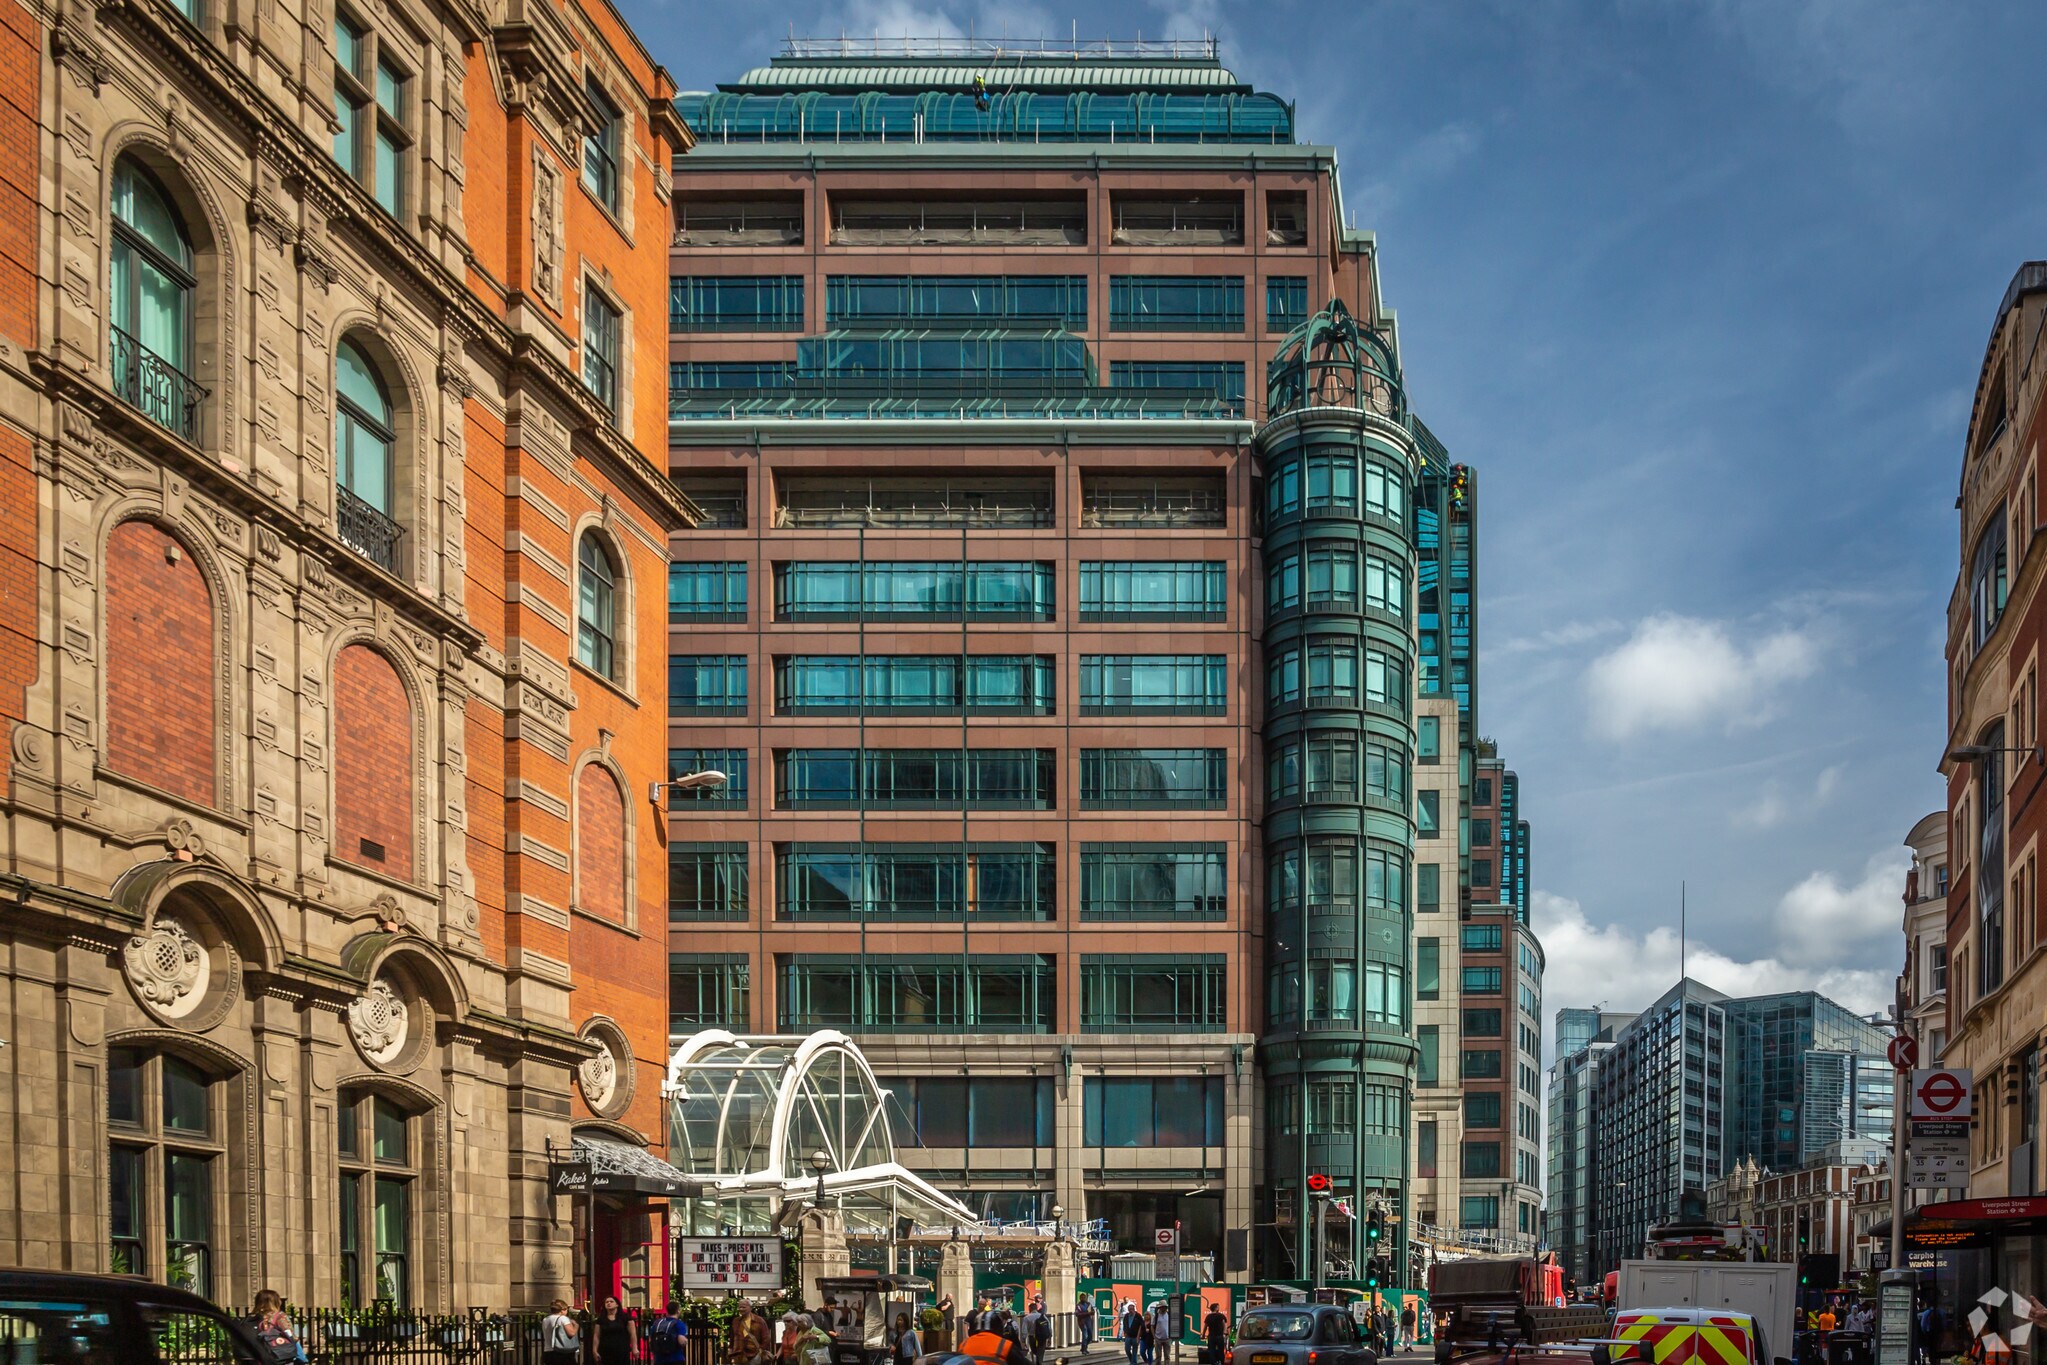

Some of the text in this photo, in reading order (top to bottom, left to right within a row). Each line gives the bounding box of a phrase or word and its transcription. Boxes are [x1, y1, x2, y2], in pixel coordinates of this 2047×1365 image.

[1895, 1041, 1911, 1064] K
[556, 1170, 587, 1188] Rake's
[701, 1243, 722, 1252] RAKES
[692, 1253, 770, 1262] OUR TASTY NEW MENU
[1908, 1252, 1944, 1260] Carphoe
[697, 1264, 715, 1272] KETEL
[718, 1264, 730, 1272] ONE
[711, 1273, 749, 1282] FROM 7.50
